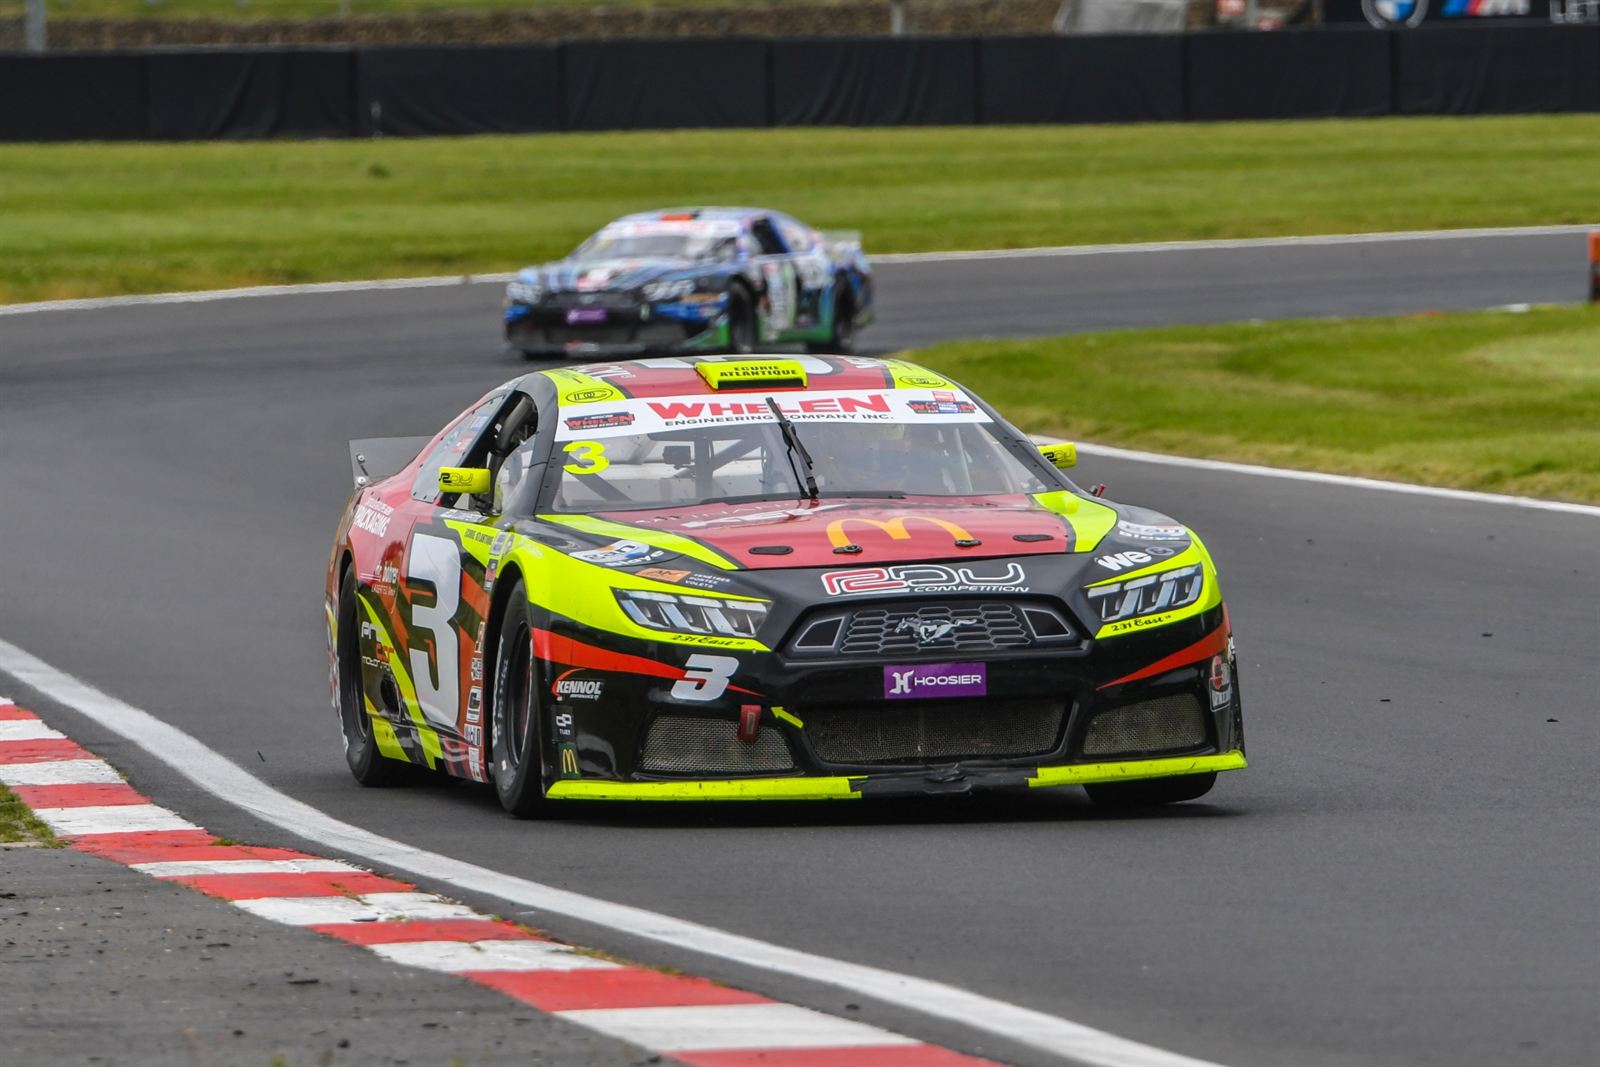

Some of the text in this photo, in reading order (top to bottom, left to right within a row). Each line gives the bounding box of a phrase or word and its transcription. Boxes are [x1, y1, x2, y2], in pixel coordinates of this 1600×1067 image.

[646, 395, 892, 419] WHELEN
[664, 415, 774, 426] ENGINEERING
[563, 441, 609, 475] 3
[914, 585, 1030, 593] COMPETITION
[407, 532, 461, 728] 3
[671, 653, 740, 701] 3
[914, 674, 982, 686] HOOSIER
[556, 680, 602, 695] KENNOL
